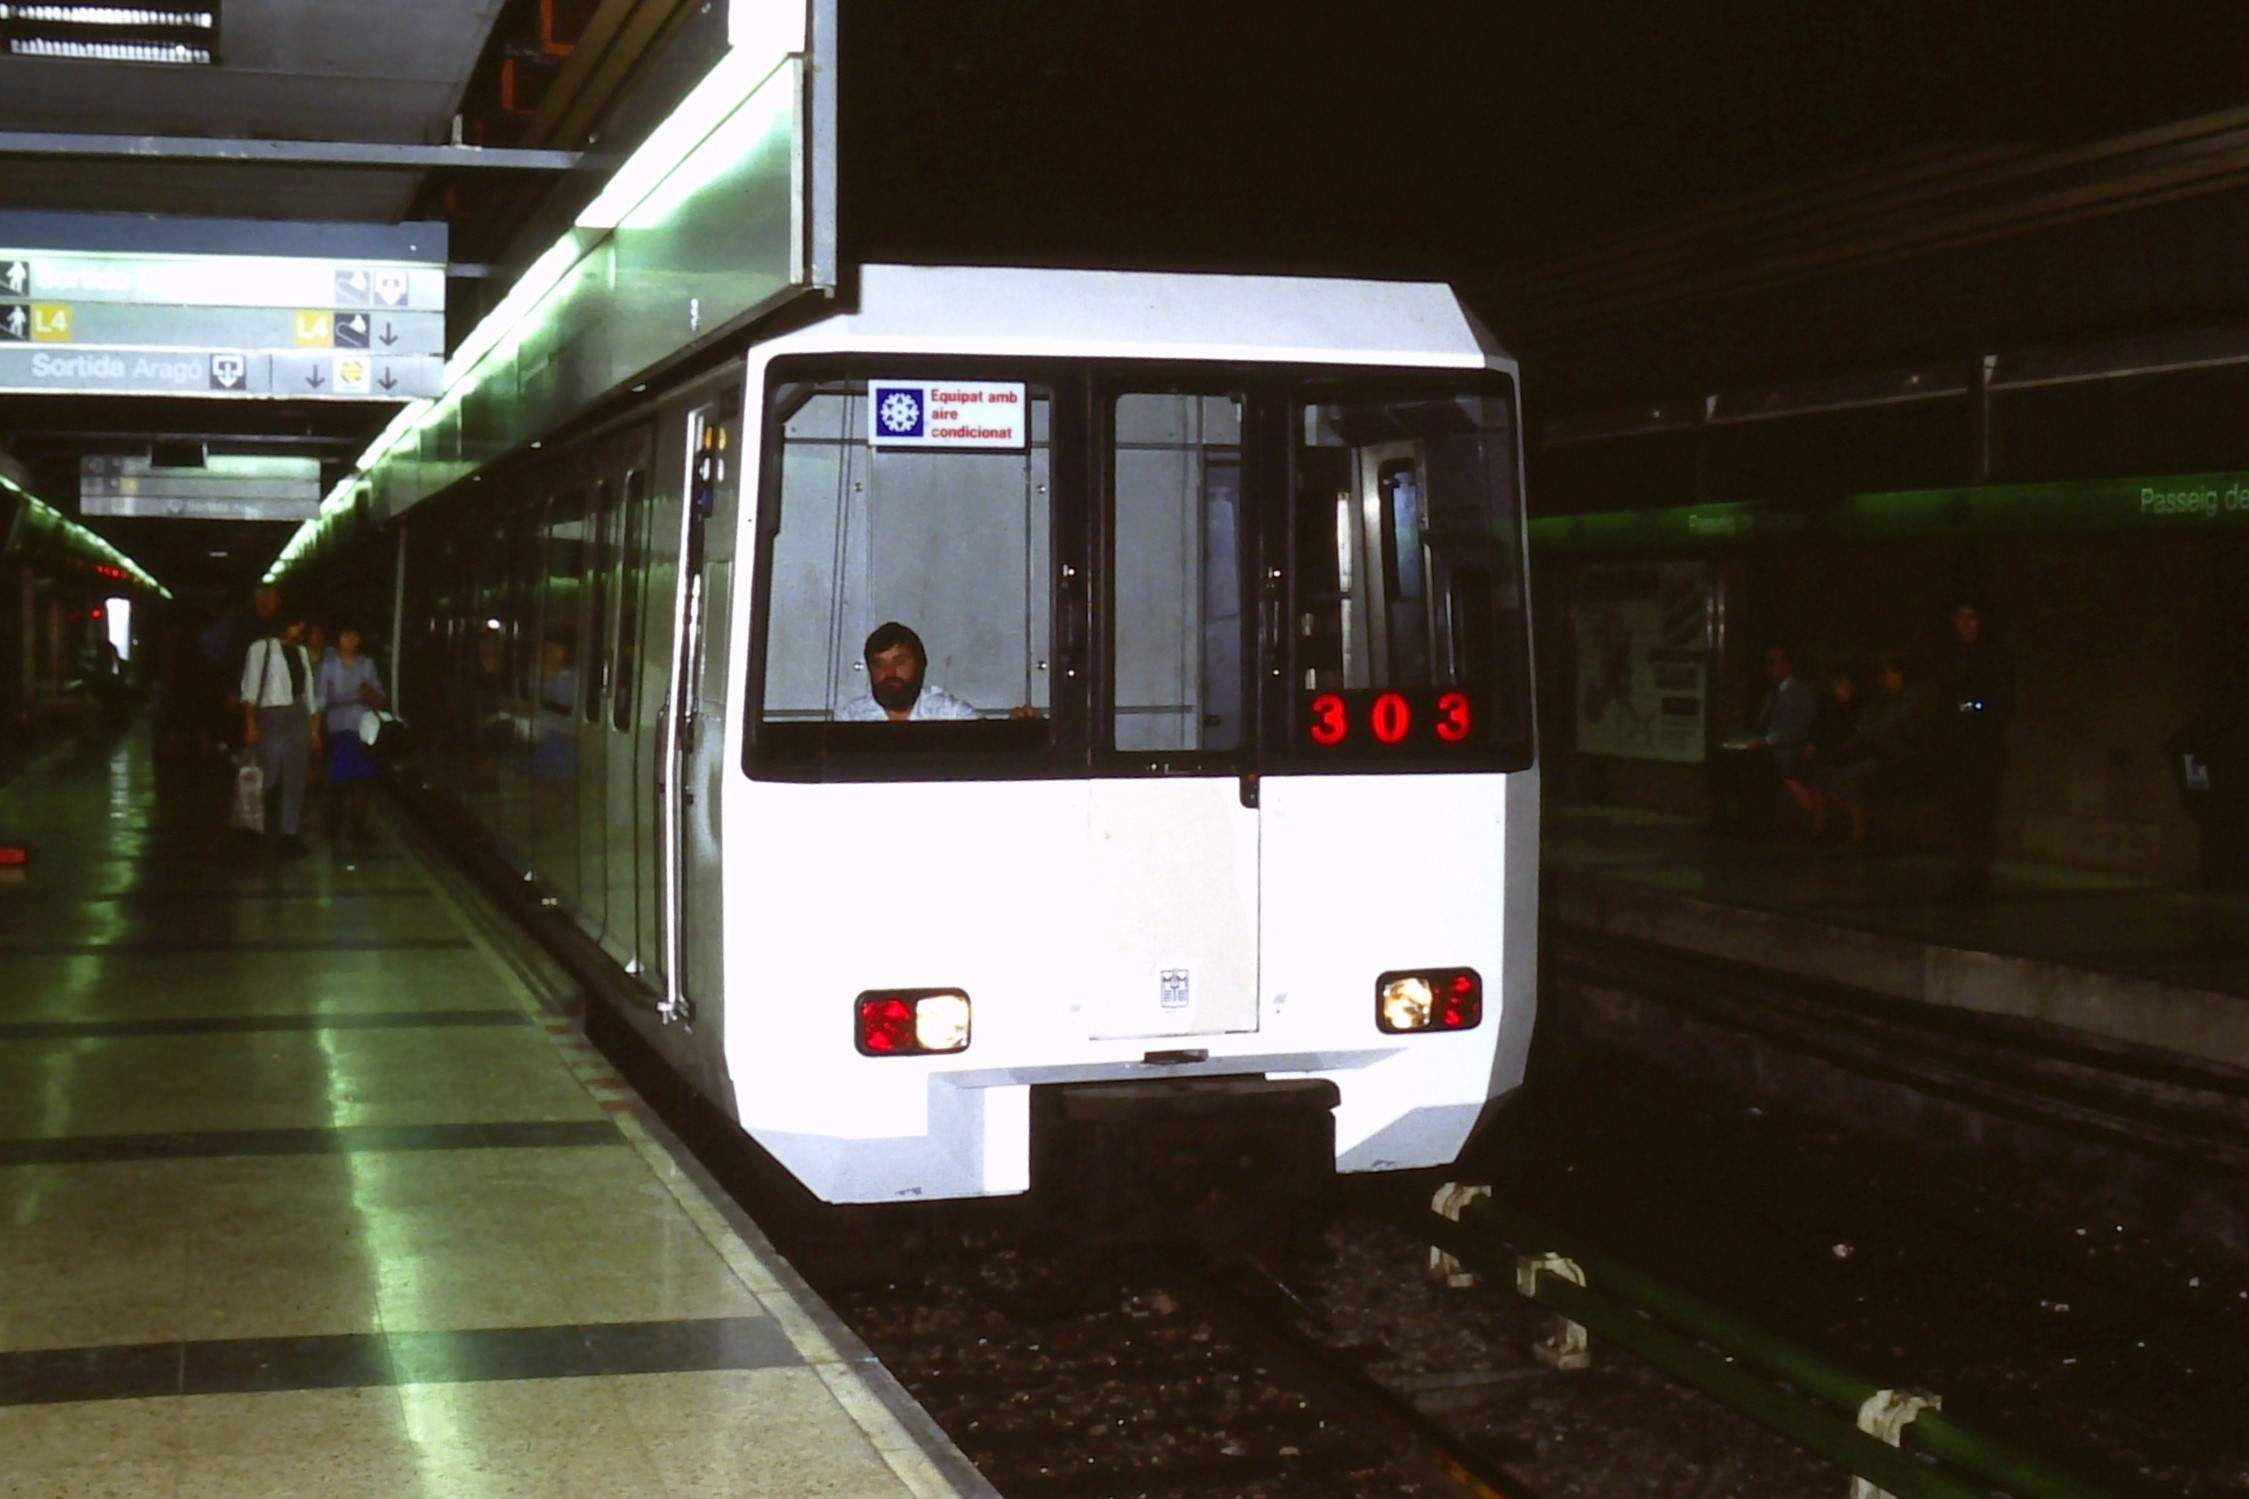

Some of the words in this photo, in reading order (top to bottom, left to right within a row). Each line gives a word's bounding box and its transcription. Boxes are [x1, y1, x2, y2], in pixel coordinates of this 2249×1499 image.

[34, 309, 69, 333] L4
[296, 315, 329, 340] L4
[31, 352, 125, 378] Sortida
[132, 354, 202, 383] Aragó
[931, 389, 984, 404] Equipat
[988, 391, 1018, 404] amb
[931, 407, 958, 420] aire
[931, 425, 1012, 439] condicionat
[2140, 484, 2218, 518] Passeig
